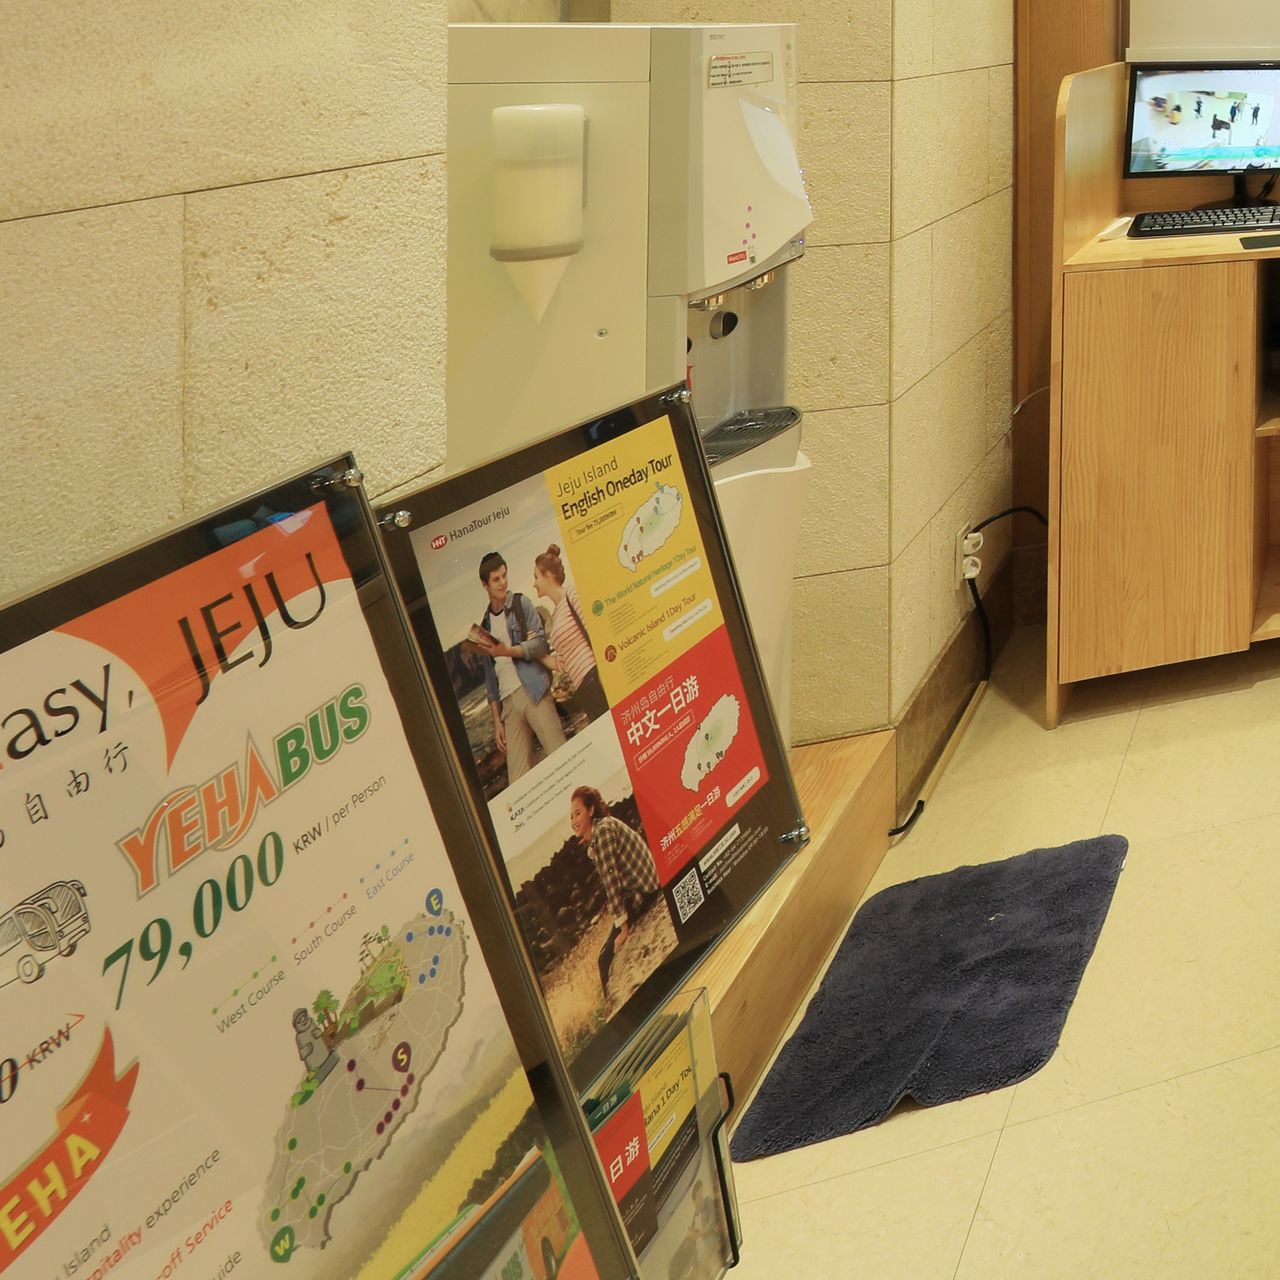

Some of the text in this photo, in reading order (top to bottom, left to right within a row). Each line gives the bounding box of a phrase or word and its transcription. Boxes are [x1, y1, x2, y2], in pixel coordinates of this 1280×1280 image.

[556, 456, 619, 499] Jeju Island
[561, 454, 673, 521] English Oneday Tour
[431, 535, 448, 550] HNT
[604, 596, 617, 608] The
[616, 584, 633, 603] World
[632, 574, 653, 594] Natural
[618, 629, 647, 651] Volcanic
[646, 613, 666, 633] Island
[681, 592, 697, 607] Tour
[0, 552, 326, 770] asy, JEJU
[621, 675, 674, 726] 济州岛自由行
[627, 675, 699, 746] 中文一日游
[101, 830, 284, 1011] 79,000
[292, 822, 323, 855] KRW
[331, 804, 351, 830] per
[350, 775, 387, 810] Person
[365, 851, 416, 901] East Course
[430, 894, 443, 911] E
[293, 904, 358, 967] South Course
[216, 969, 287, 1035] West Course
[25, 1022, 72, 1070] KRW
[395, 1047, 408, 1066] S
[609, 1136, 640, 1184] 日游
[144, 1148, 221, 1229] experience
[63, 1222, 112, 1277] Island
[184, 1199, 234, 1255] Service
[273, 1233, 291, 1257] W
